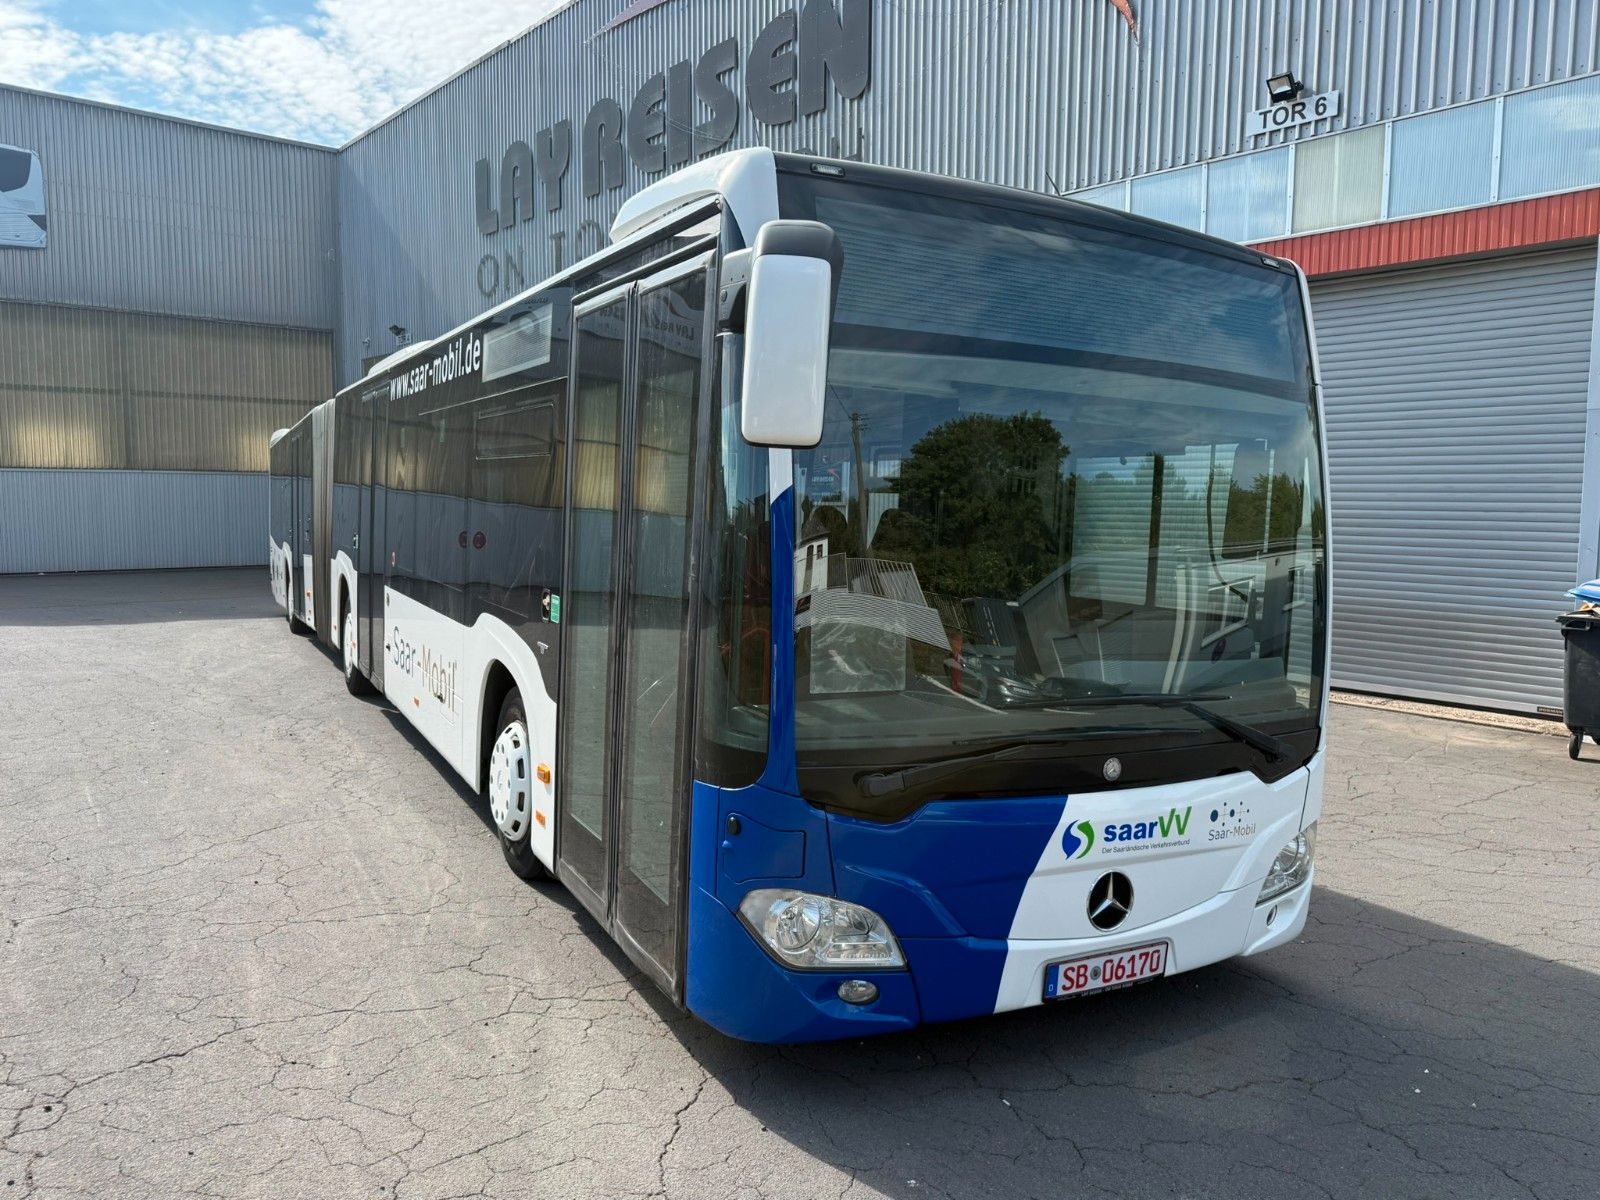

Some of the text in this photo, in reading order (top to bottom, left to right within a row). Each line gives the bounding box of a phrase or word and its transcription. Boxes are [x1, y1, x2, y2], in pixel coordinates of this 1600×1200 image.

[474, 0, 872, 236] LAY REISEN
[1258, 96, 1327, 129] TOR 6
[477, 245, 525, 297] ON
[389, 332, 481, 402] www.saar-mobil.de
[1101, 838, 1190, 854] Der Saarländische Verkehrsverbund
[1208, 823, 1256, 841] Saar-Mobil
[1061, 963, 1089, 992] SB
[1102, 949, 1161, 983] 06170
